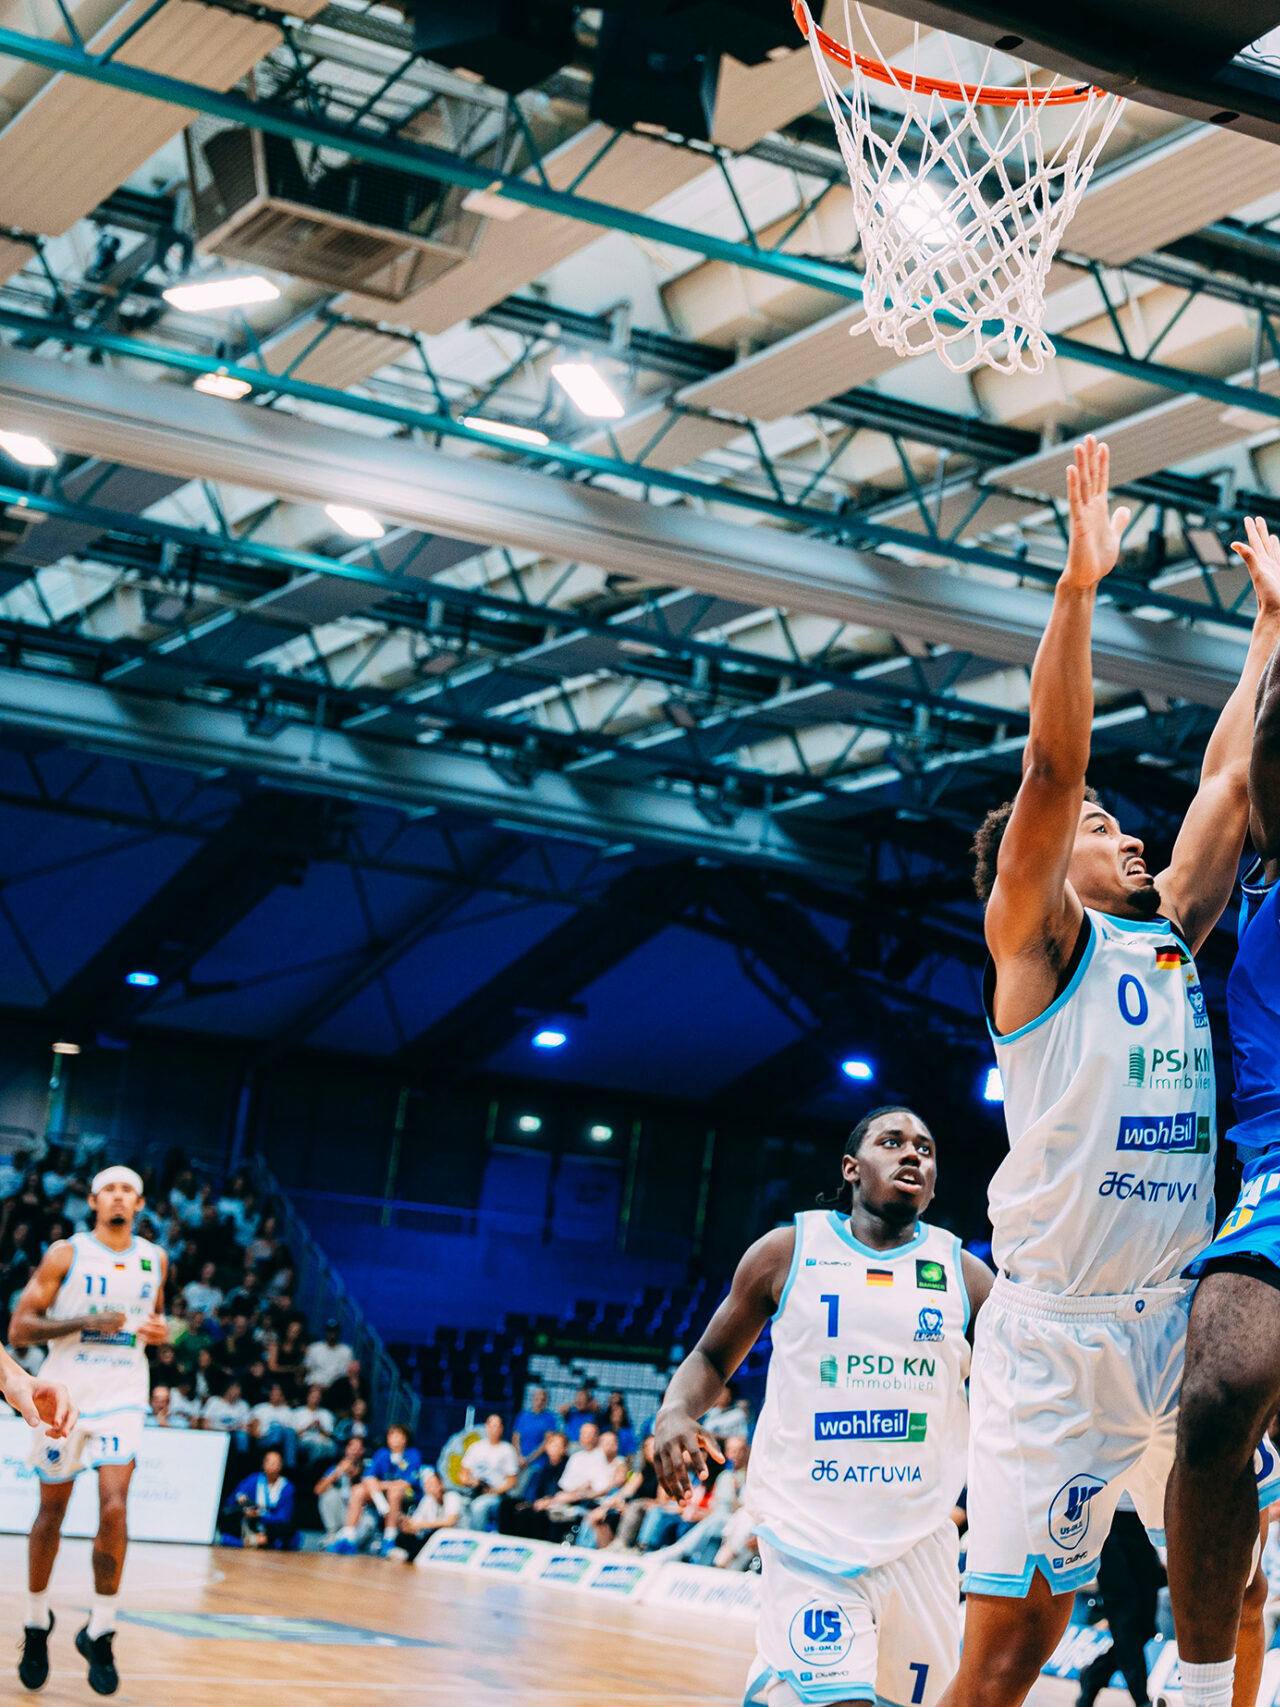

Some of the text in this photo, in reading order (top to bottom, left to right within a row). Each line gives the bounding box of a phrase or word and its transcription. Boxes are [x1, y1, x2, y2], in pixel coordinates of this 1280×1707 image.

[1117, 973, 1149, 1026] 0
[84, 1275, 108, 1297] 11
[820, 1294, 840, 1338] 1
[847, 1355, 936, 1377] PSD KN
[846, 1377, 935, 1391] Immobilien
[820, 1412, 905, 1437] wohlfeil
[842, 1465, 923, 1483] ATRUVIA
[804, 1609, 842, 1643] US
[909, 1662, 930, 1705] 1
